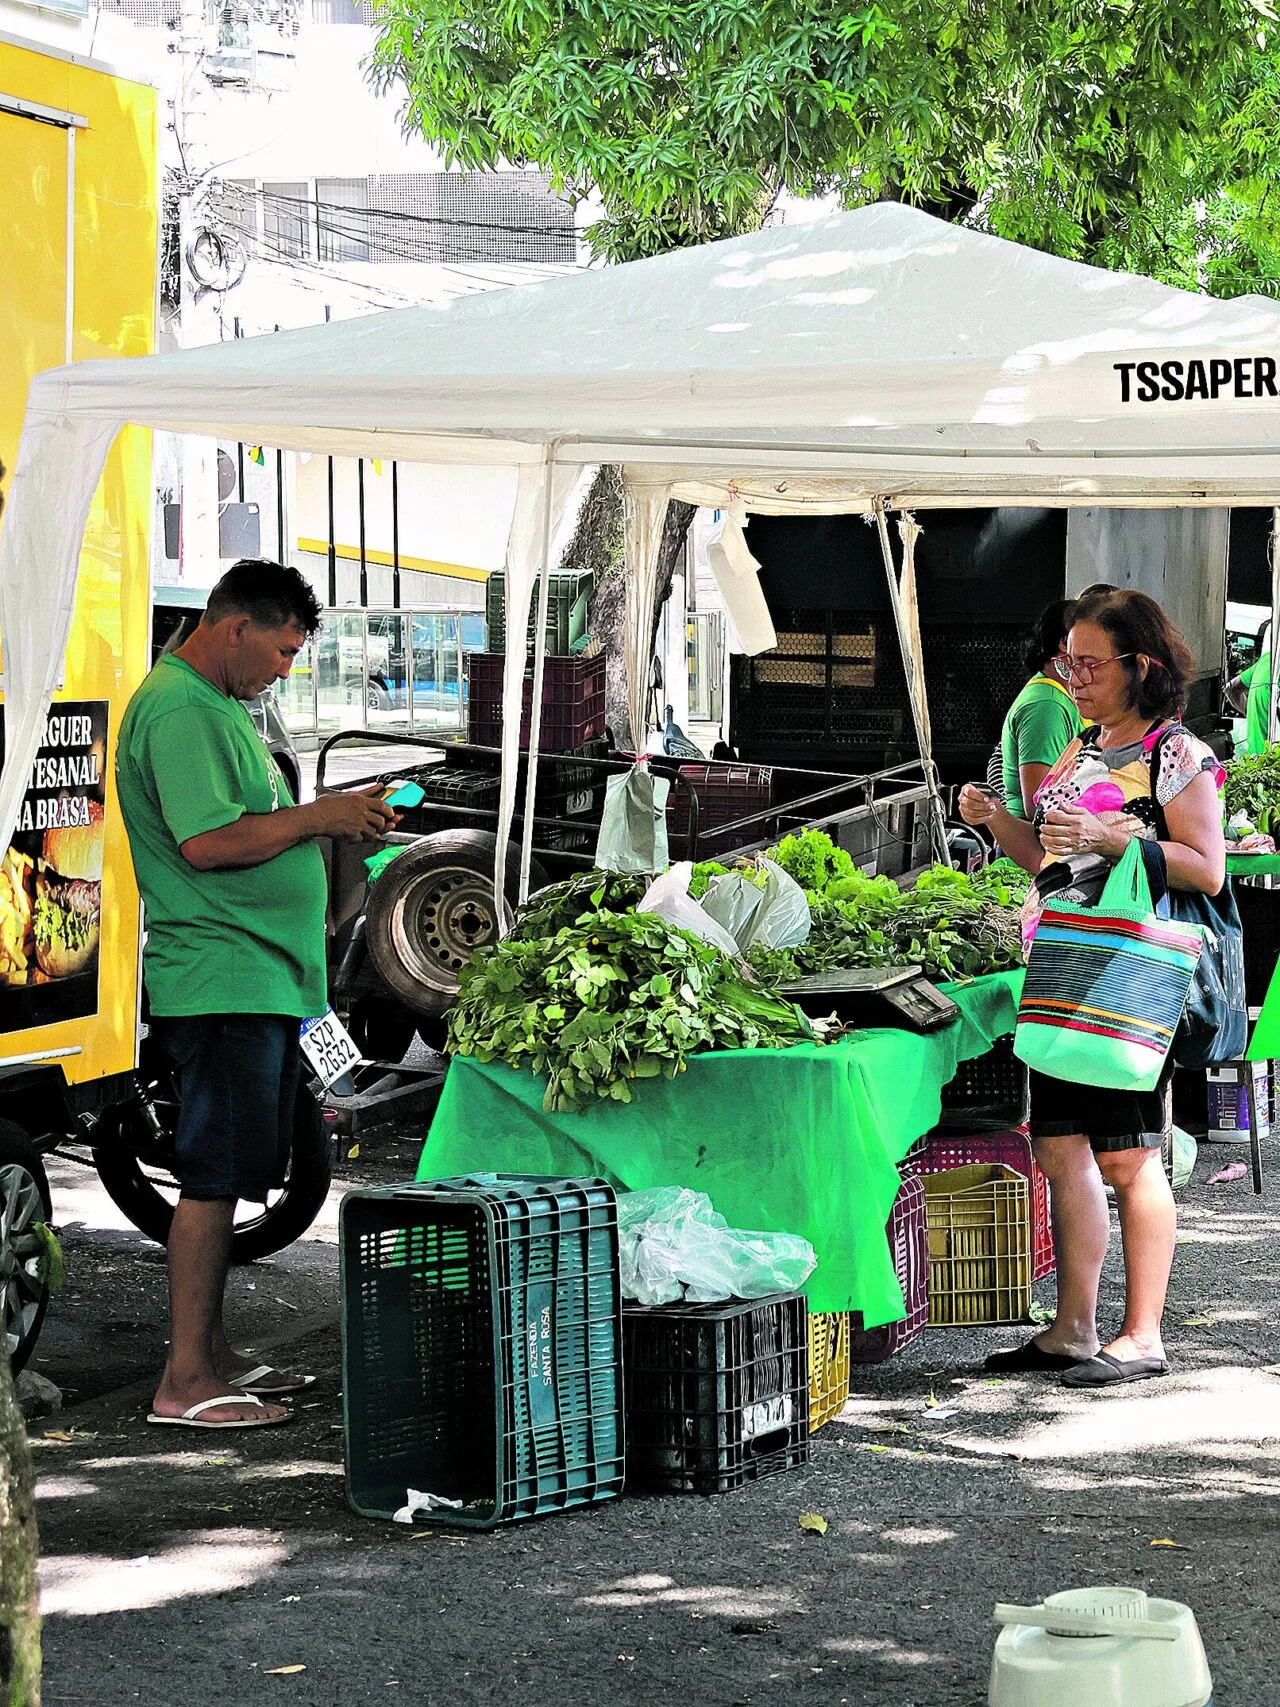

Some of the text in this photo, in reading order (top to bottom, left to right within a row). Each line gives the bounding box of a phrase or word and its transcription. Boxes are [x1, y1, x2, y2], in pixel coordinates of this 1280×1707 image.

[36, 796, 91, 831] BRASA
[309, 1020, 336, 1053] SZP
[319, 1038, 355, 1078] 2G32
[529, 1321, 539, 1378] FAZENDA
[540, 1306, 552, 1386] SANTA ROSA
